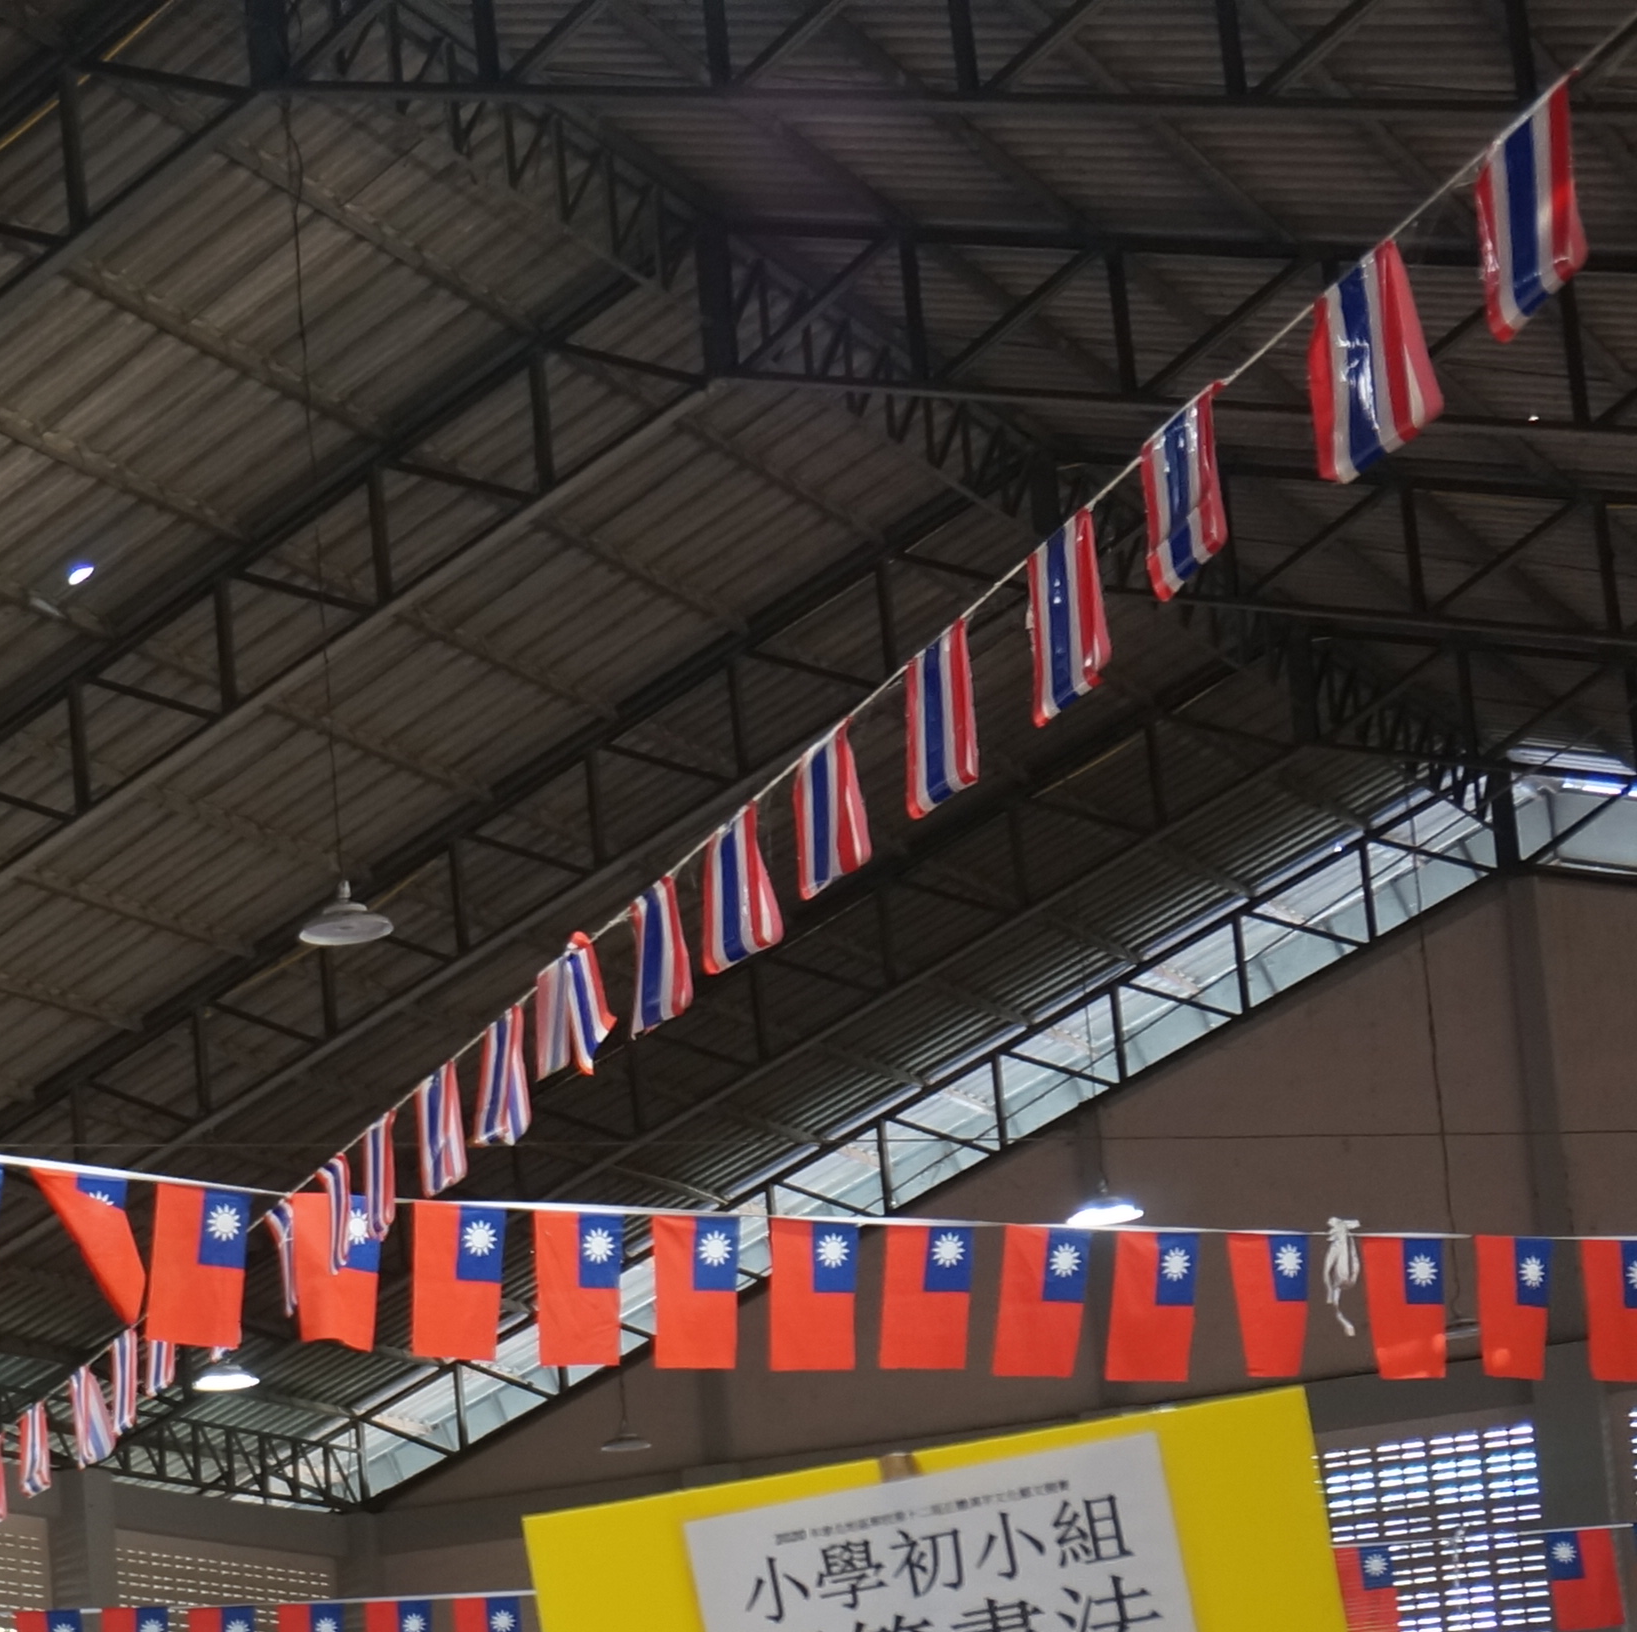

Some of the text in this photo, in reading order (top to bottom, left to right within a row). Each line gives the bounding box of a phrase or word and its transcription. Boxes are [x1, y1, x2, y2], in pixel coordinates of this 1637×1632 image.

[744, 1493, 1133, 1624] 小學初小組
